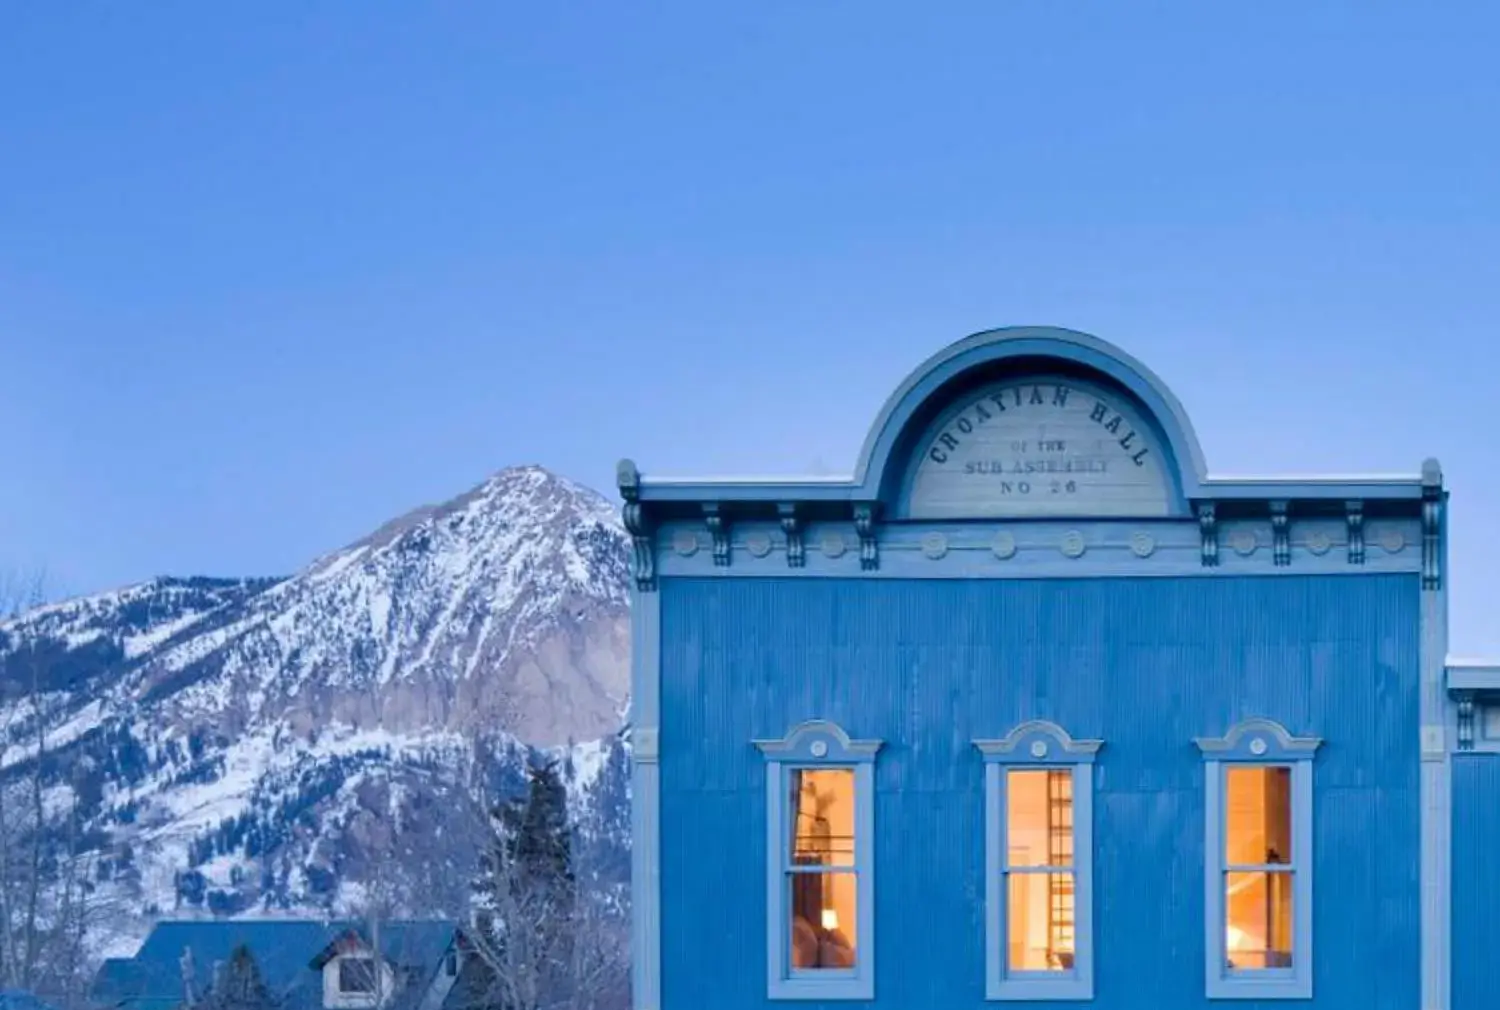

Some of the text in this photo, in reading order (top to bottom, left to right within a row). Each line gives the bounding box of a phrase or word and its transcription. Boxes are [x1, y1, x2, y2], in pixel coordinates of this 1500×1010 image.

[930, 384, 1149, 467] CROATIAN HALL
[963, 460, 1002, 475] SUB
[1000, 481, 1031, 494] NO
